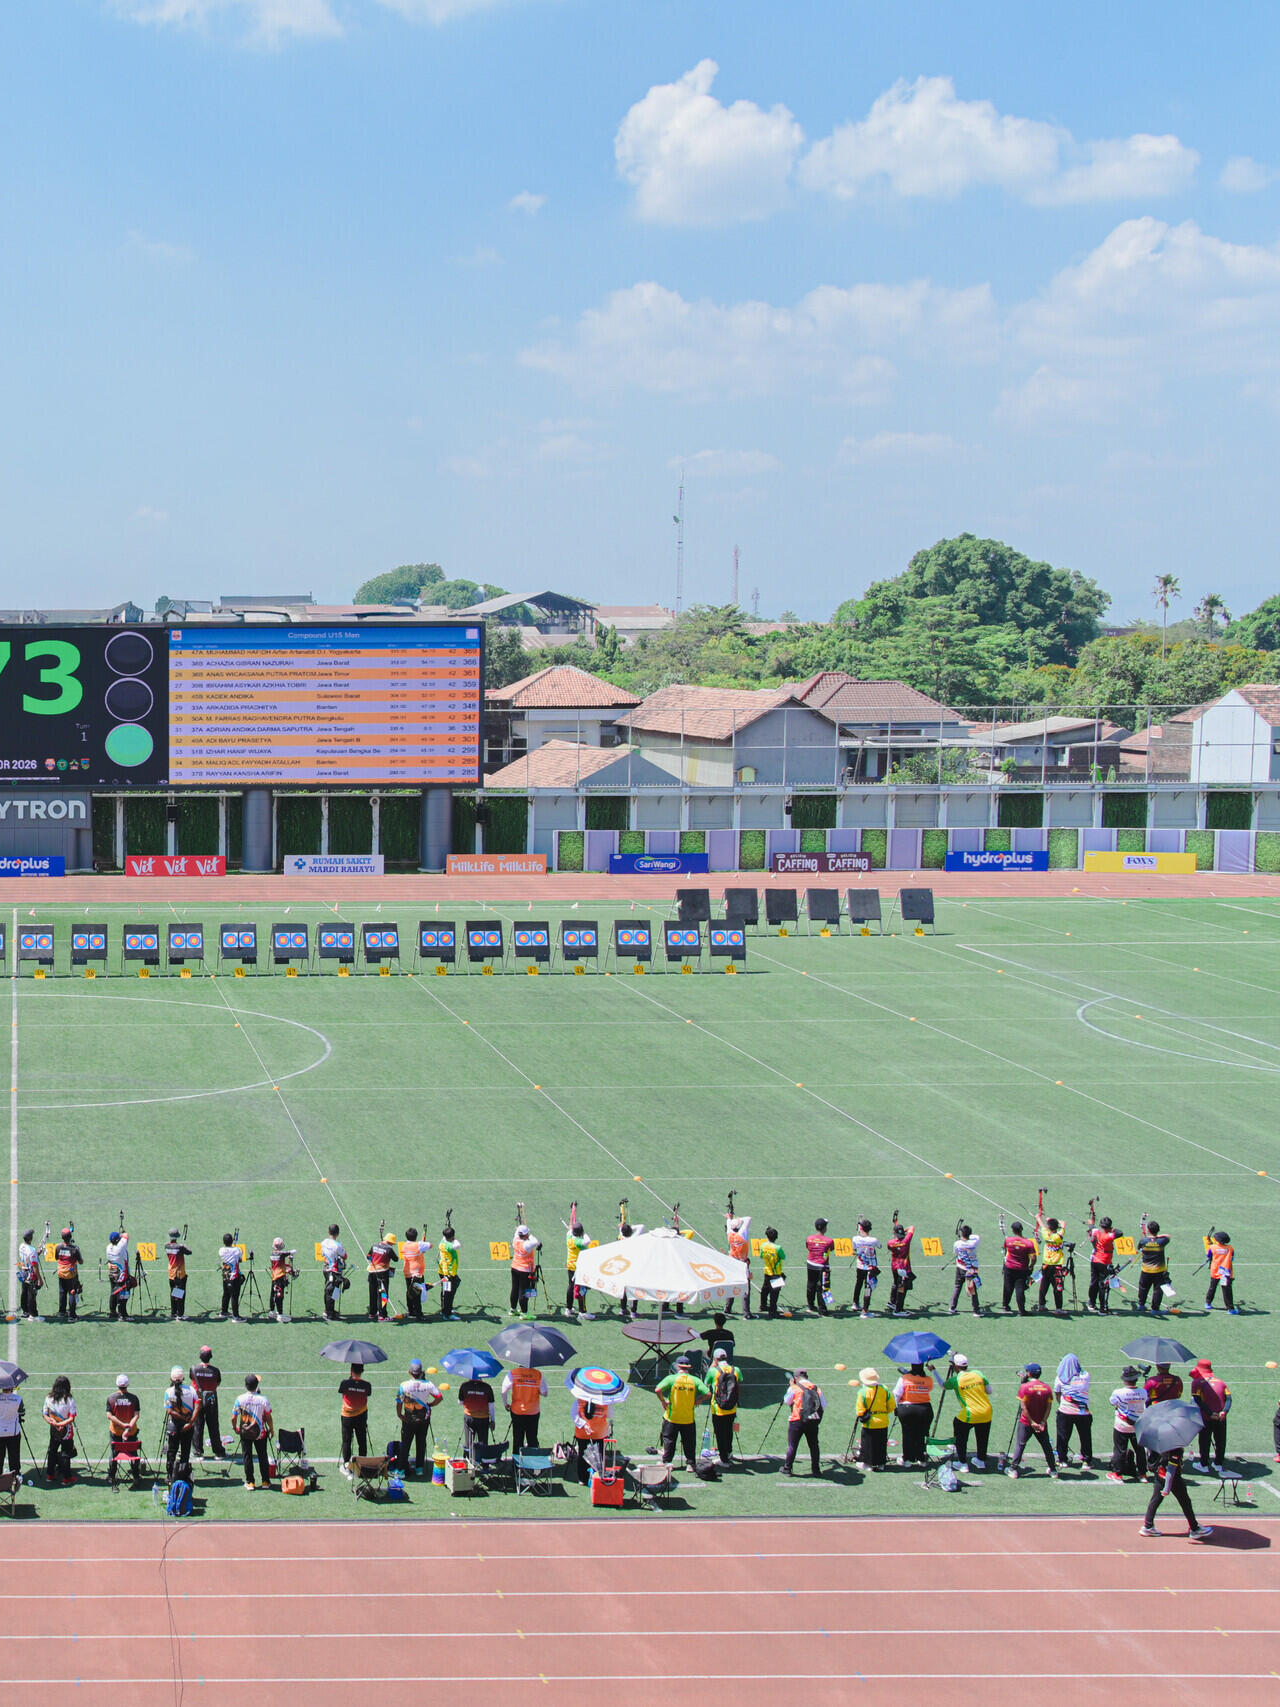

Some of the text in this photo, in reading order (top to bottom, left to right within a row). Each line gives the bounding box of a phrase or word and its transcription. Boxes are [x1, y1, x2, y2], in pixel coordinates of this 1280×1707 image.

[287, 632, 326, 640] Compound
[80, 732, 87, 741] 1
[12, 759, 37, 770] 2026
[639, 860, 676, 869] SariWangi
[778, 859, 818, 871] CAFFINO
[828, 858, 868, 871] CAFFINO
[963, 852, 1033, 867] hydroplus
[131, 857, 156, 876] Vit
[164, 857, 188, 876] Vit
[195, 857, 220, 876] Vit
[451, 861, 543, 872] MilkLife MilkLife
[139, 1244, 154, 1258] 38
[492, 1244, 508, 1257] 42
[835, 1241, 850, 1253] 46
[924, 1240, 939, 1253] 47
[1116, 1238, 1134, 1252] 49
